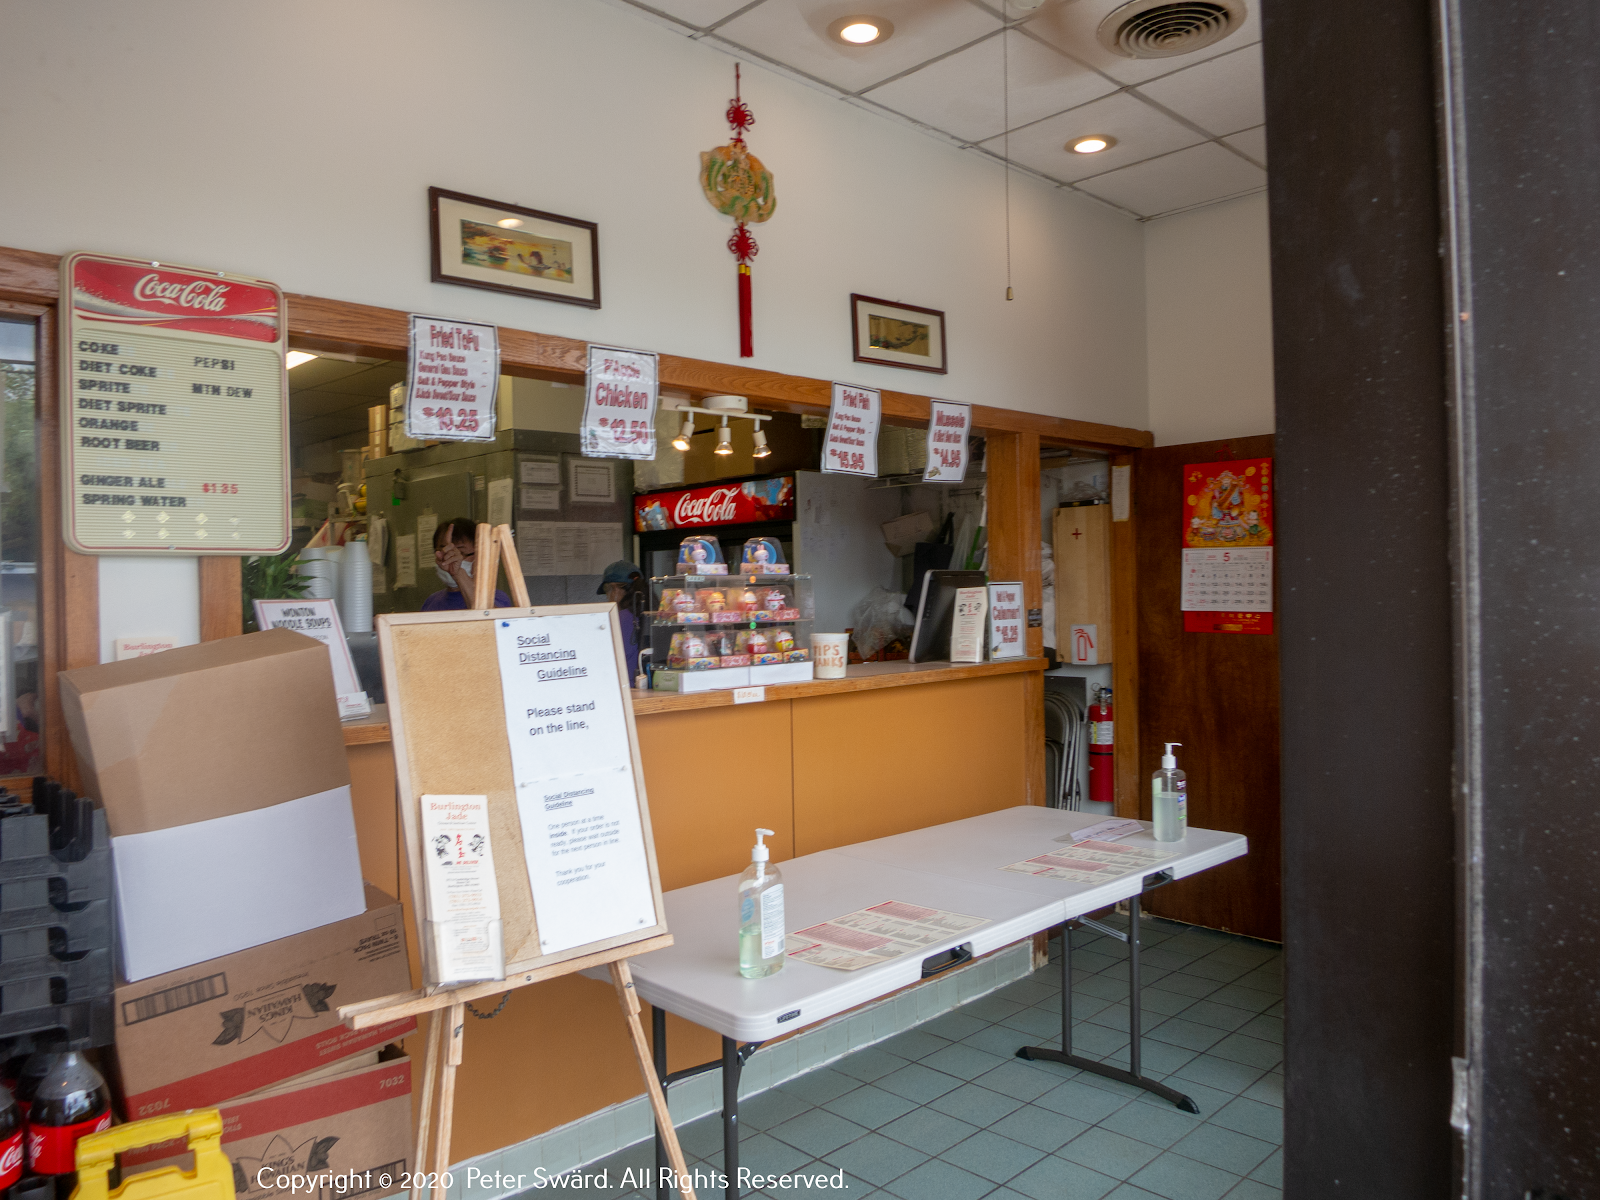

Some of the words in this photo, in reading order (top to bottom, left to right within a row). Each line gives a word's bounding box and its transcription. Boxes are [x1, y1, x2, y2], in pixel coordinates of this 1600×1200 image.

[133, 273, 231, 312] Coca-Cola
[430, 325, 454, 349] Fried
[78, 341, 119, 355] COKE
[79, 360, 111, 374] DIET
[119, 364, 157, 378] COKE
[78, 379, 131, 394] SPRITE
[438, 377, 458, 389] Pepper
[226, 386, 253, 399] DEW
[595, 382, 648, 410] Chicken
[79, 398, 112, 411] DIET
[117, 401, 167, 415] SPRITE
[78, 417, 139, 431] ORANGE
[422, 407, 479, 432] $10.25
[599, 417, 648, 445] $12.50
[81, 436, 121, 449] ROOT
[125, 439, 160, 451] BEER
[80, 474, 134, 487] GINGER
[138, 477, 166, 488] ALE
[82, 494, 135, 506] SPRING
[141, 496, 187, 507] WATER
[674, 487, 742, 525] Coca-Cola
[1223, 552, 1230, 562] 5
[282, 607, 316, 617] WONTON
[271, 619, 303, 629] NOODLE
[306, 617, 331, 628] SOUPS
[123, 642, 173, 651] Burlington
[517, 633, 550, 646] Social
[519, 649, 577, 664] Distancing
[813, 644, 840, 656] TIPS
[537, 666, 588, 680] Guideline
[526, 707, 563, 719] Please
[566, 700, 596, 714] stand
[529, 725, 544, 737] on
[546, 723, 563, 734] the
[543, 793, 562, 801] Social
[563, 788, 595, 798] Distancing
[430, 802, 481, 812] Burlington
[544, 800, 573, 810] Guideline
[446, 811, 468, 820] Jade
[548, 822, 560, 830] One
[561, 819, 580, 829] person
[576, 826, 589, 836] your
[590, 823, 604, 831] order
[569, 836, 586, 845] please
[600, 829, 620, 838] outside
[584, 842, 602, 850] person
[555, 868, 573, 877] Thank
[574, 867, 584, 875] you
[594, 862, 606, 870] your
[248, 993, 302, 1018] HAWAIIAN
[319, 1043, 341, 1057] SWEET
[380, 1075, 405, 1091] 7032
[138, 1098, 170, 1116] 7032
